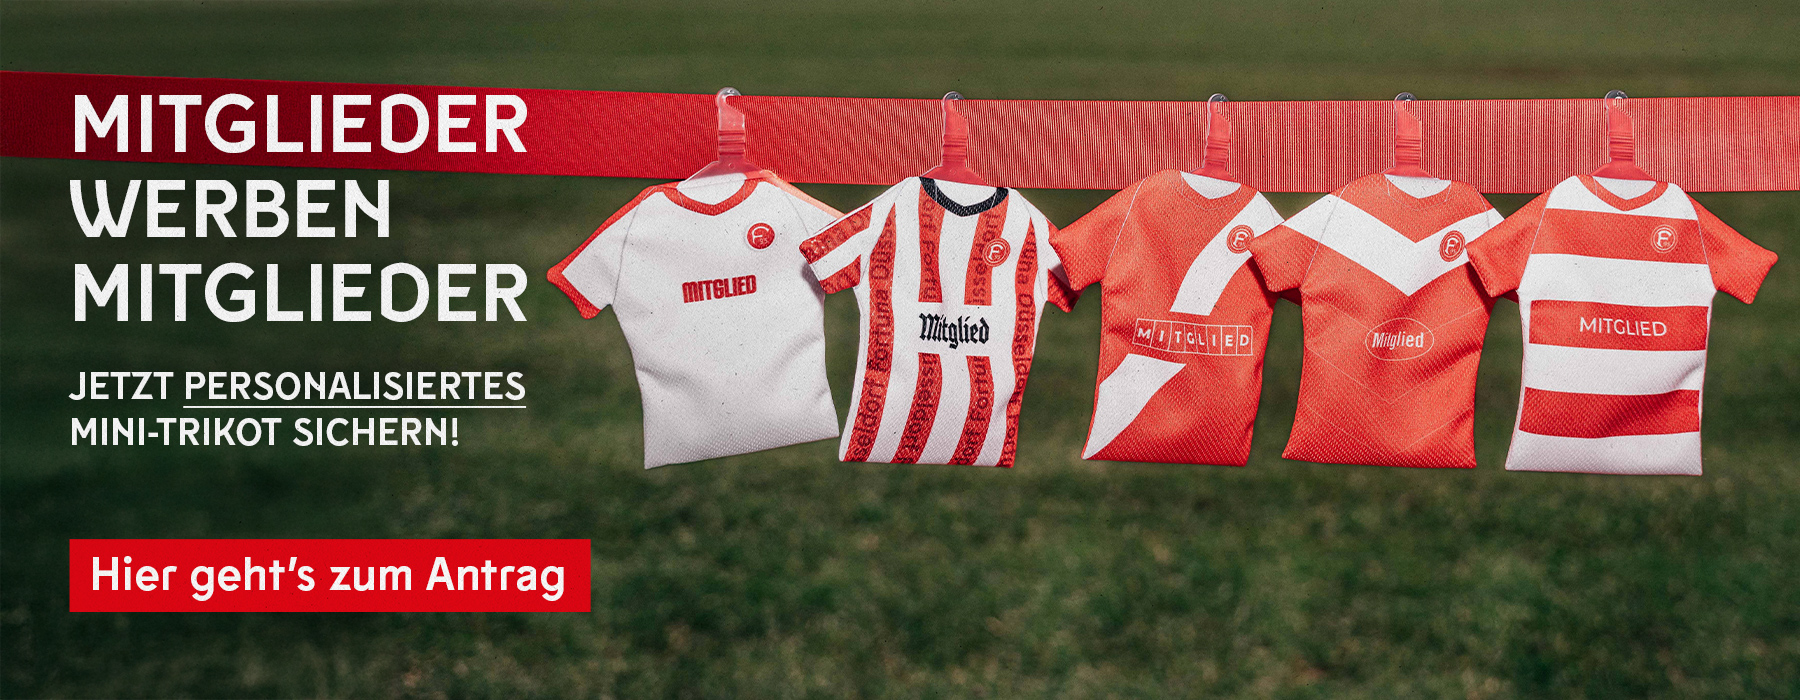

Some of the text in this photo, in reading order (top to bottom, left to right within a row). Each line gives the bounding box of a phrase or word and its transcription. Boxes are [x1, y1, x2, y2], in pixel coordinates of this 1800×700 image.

[682, 274, 757, 303] MITGLIED
[918, 312, 989, 350] Mitglied
[1580, 317, 1667, 337] MITGLIED
[1138, 328, 1250, 347] MITGLIED
[1372, 331, 1424, 350] Mitglied
